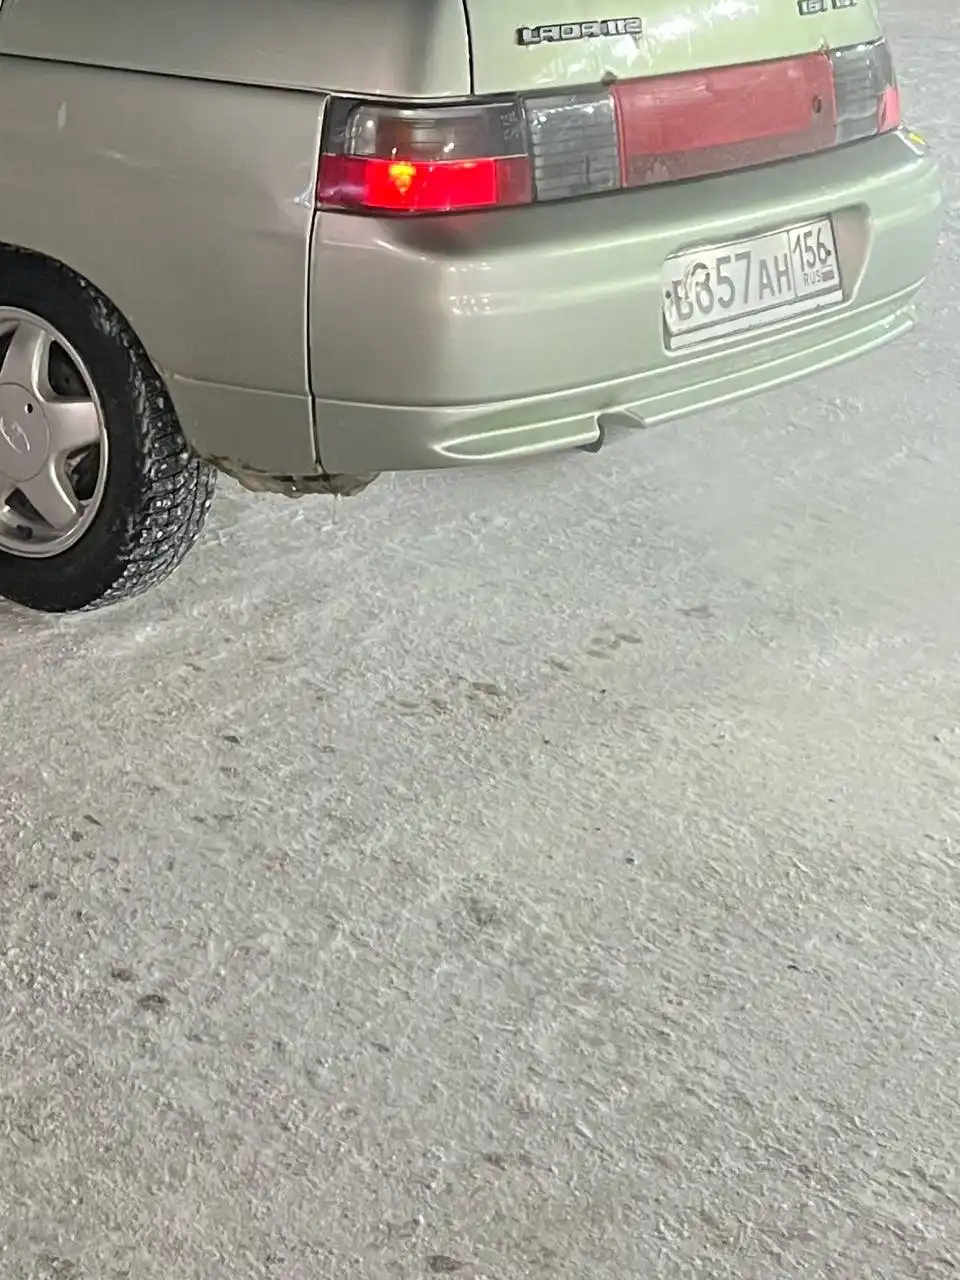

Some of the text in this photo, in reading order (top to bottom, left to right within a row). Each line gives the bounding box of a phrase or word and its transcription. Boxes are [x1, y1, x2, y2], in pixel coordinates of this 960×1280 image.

[517, 20, 599, 45] LADA
[793, 227, 830, 272] 156
[803, 269, 821, 287] RUS
